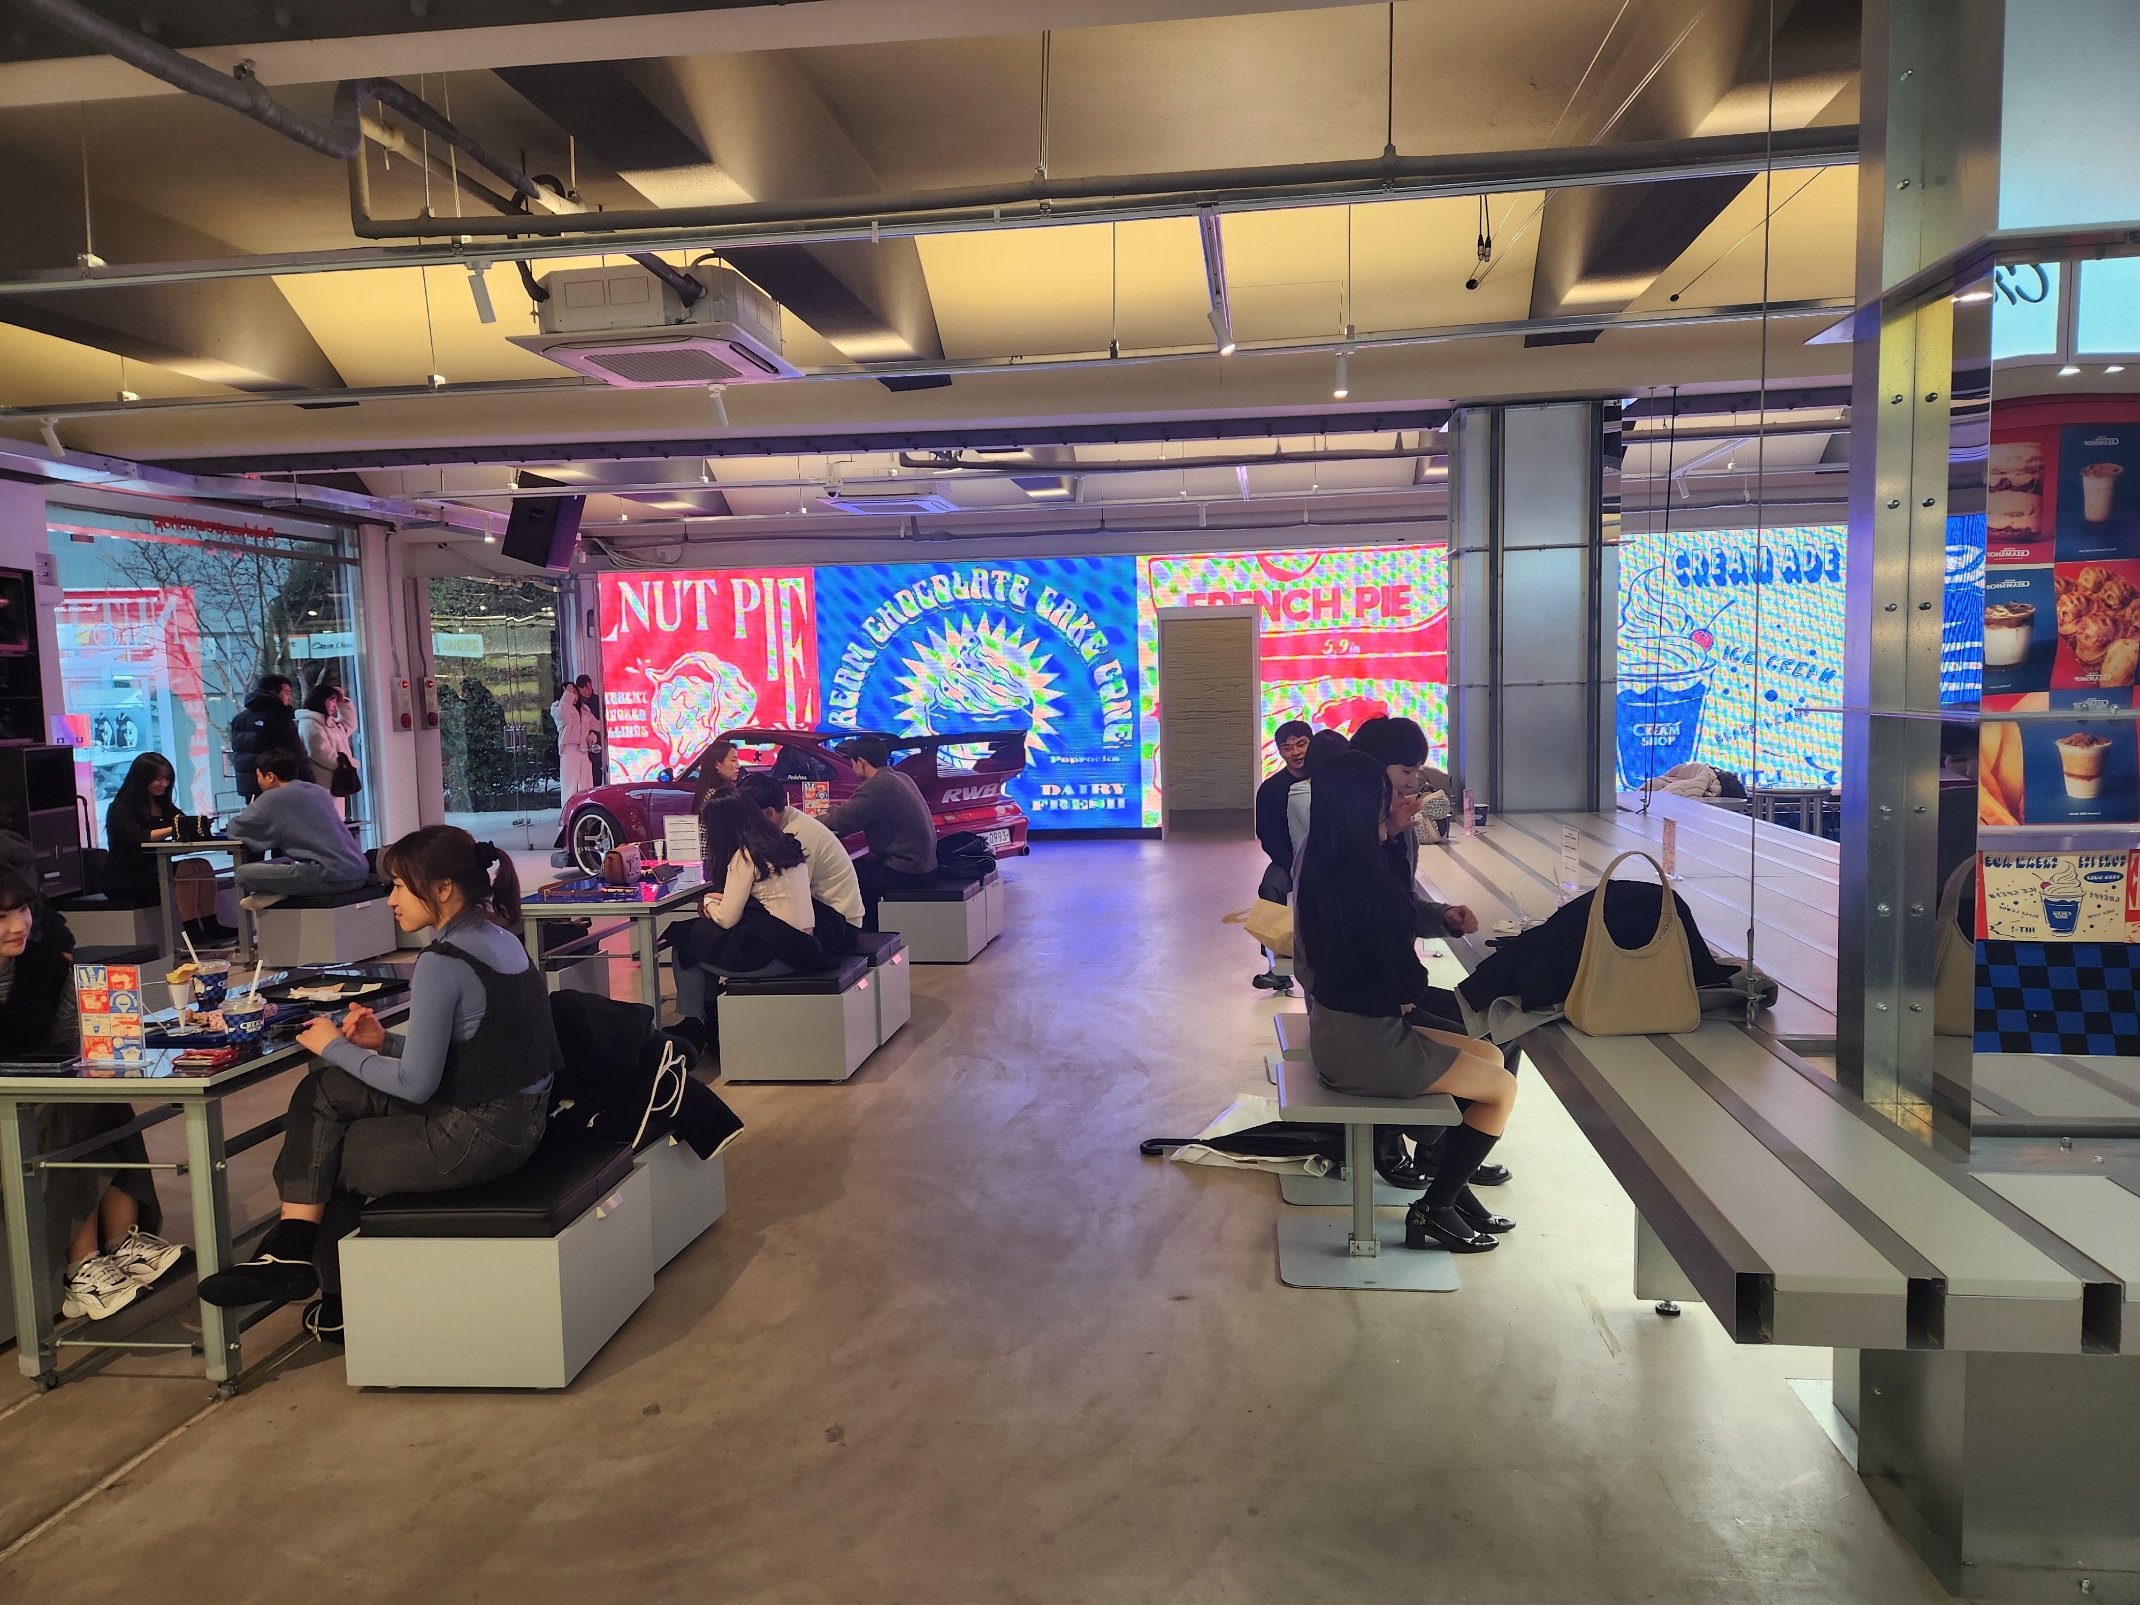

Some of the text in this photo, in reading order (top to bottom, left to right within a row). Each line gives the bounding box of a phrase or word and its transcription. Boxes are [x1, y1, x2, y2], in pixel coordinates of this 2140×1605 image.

[1673, 543, 1841, 587] CREAM ADE
[1355, 584, 1412, 619] PIE
[730, 577, 812, 731] PIE
[828, 568, 1134, 745] REAM CHOCOLATE CAKE CONE
[1723, 645, 1756, 665] ICE
[1632, 721, 1682, 737] CREAM
[1641, 736, 1676, 747] SHOP
[941, 782, 999, 804] RWB
[1040, 783, 1128, 796] DAIRY
[990, 831, 1007, 844] 0993
